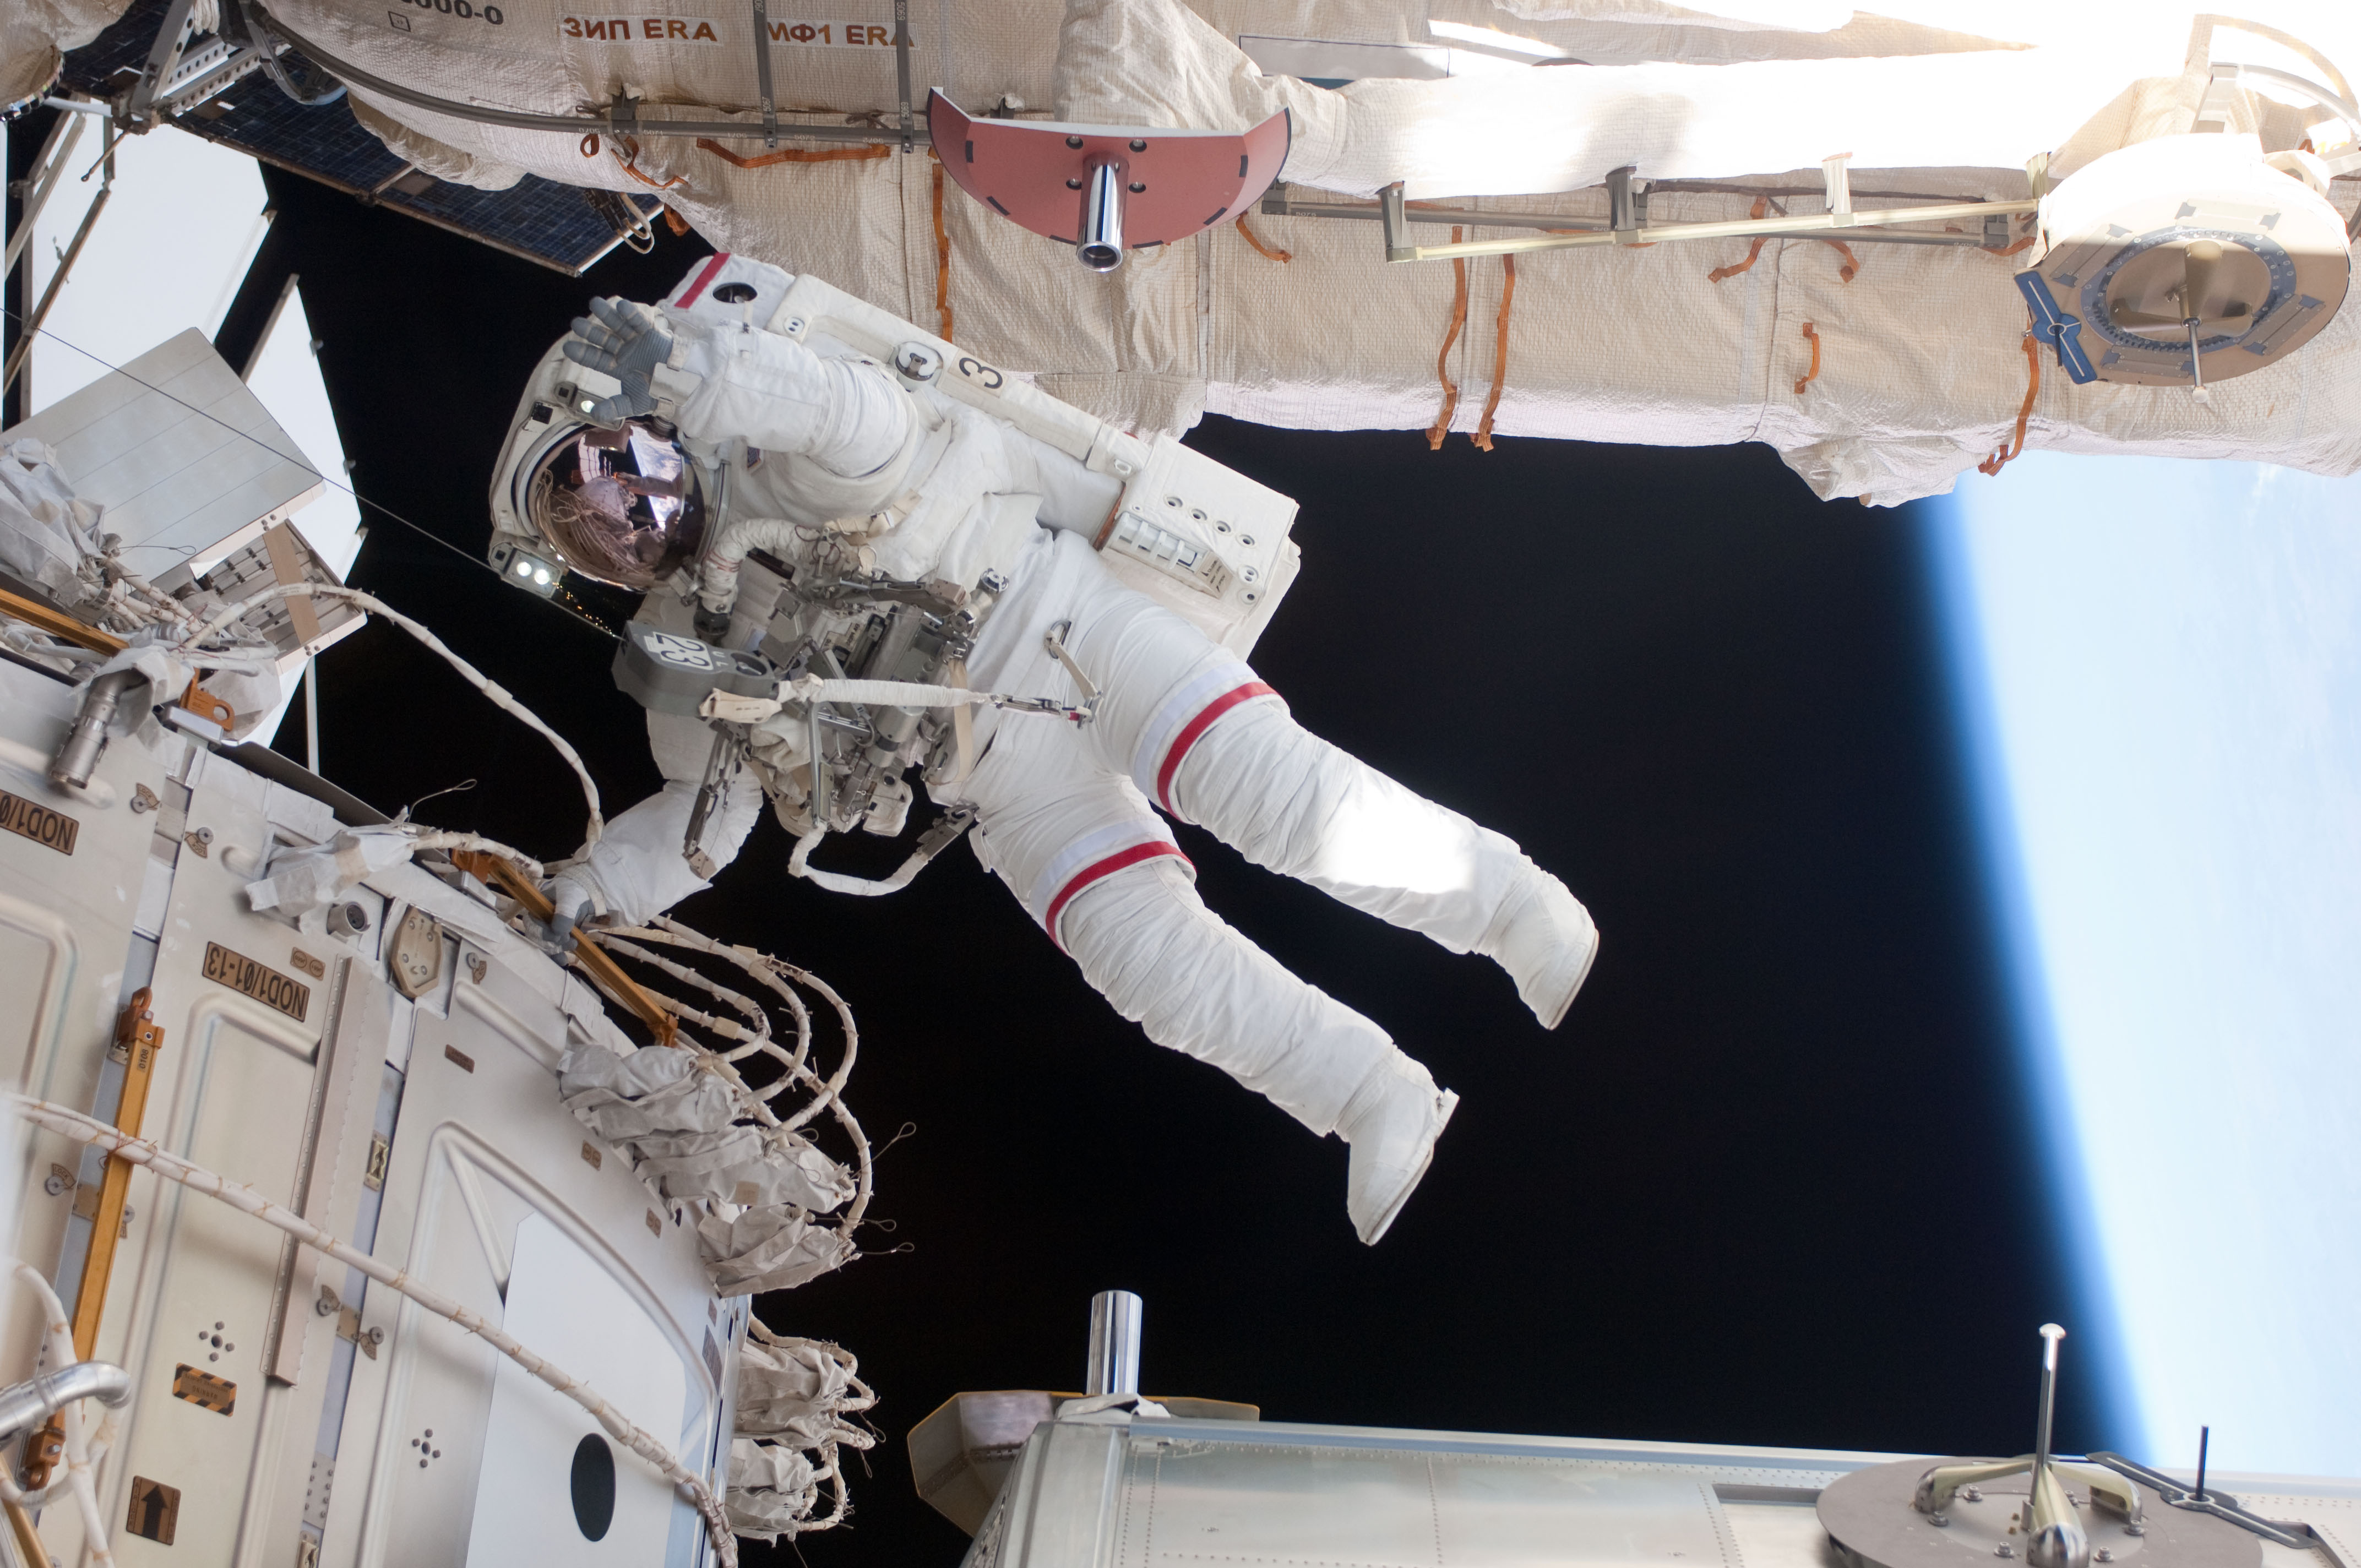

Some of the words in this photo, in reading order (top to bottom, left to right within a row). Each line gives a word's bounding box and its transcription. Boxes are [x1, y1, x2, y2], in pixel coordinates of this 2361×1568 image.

[401, 0, 504, 25] 00-0
[897, 1, 906, 21] 5069
[563, 17, 630, 40] ЗИП
[643, 19, 717, 42] ERA
[762, 96, 771, 112] 5067
[900, 101, 910, 117] 5069
[959, 357, 1003, 389] 3
[139, 787, 152, 799] LOCK
[192, 842, 206, 856] LOCK
[207, 945, 307, 1018] NOD1/01-13
[139, 1048, 149, 1069] 0108
[55, 1167, 70, 1179] LOCK
